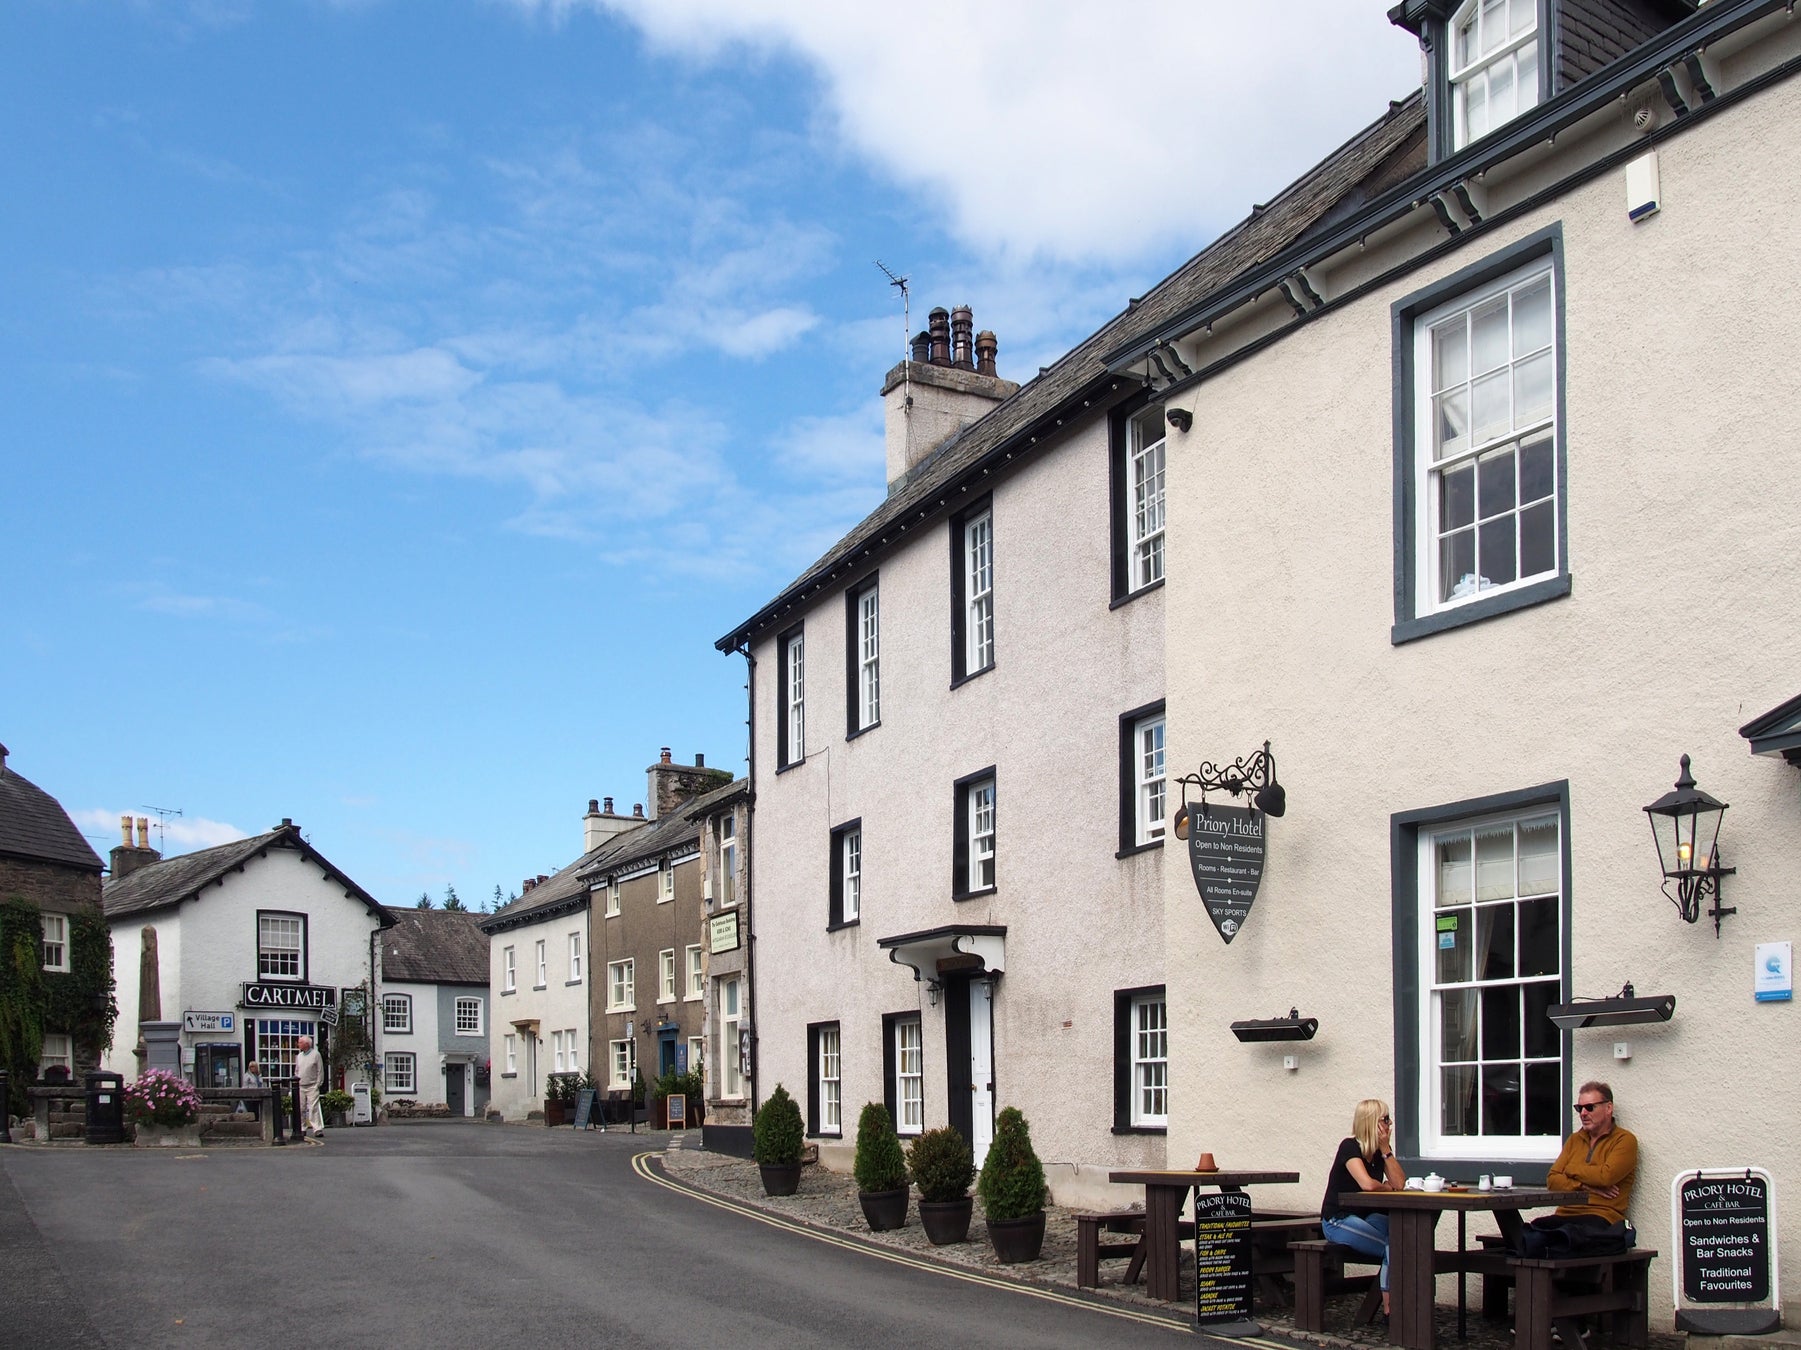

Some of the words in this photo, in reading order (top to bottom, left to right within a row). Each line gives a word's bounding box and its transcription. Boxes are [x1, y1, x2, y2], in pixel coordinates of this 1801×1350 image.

[1196, 814, 1230, 838] Priory
[1233, 818, 1261, 836] Hotel
[1196, 840, 1212, 850] Open
[1234, 844, 1262, 854] Residents
[1199, 864, 1216, 872] Rooms
[1221, 866, 1246, 874] Restaurant
[1233, 888, 1252, 896] En-suite
[248, 987, 330, 1006] CARTMEL
[1684, 1185, 1724, 1201] PRIORY
[1727, 1184, 1762, 1198] HOTEL
[1197, 1196, 1225, 1210] PRIORY
[1226, 1196, 1250, 1208] HOTEL
[1684, 1219, 1702, 1227] Open
[1730, 1216, 1764, 1224] Residents
[1690, 1235, 1749, 1245] Sandwiches
[1752, 1234, 1759, 1242] &
[1697, 1249, 1714, 1258] Bar
[1717, 1247, 1753, 1257] Snacks
[1700, 1267, 1751, 1277] Traditional
[1701, 1280, 1752, 1290] Favourites
